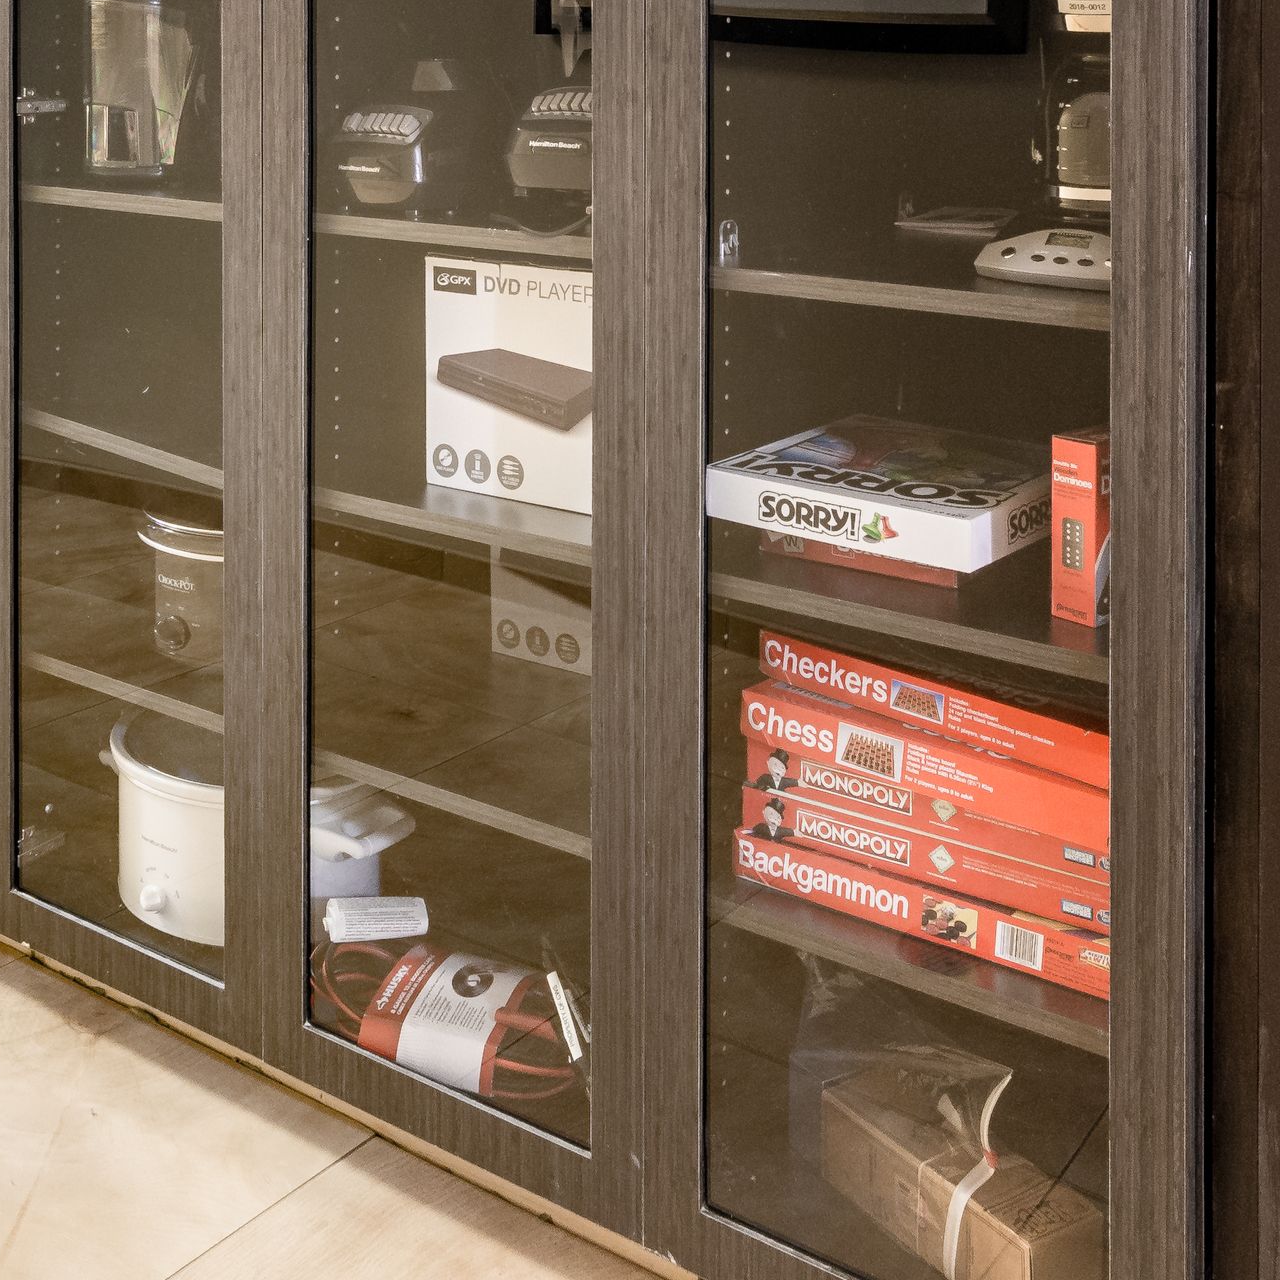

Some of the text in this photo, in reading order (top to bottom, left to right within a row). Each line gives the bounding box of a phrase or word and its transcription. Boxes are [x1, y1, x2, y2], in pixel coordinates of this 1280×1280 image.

[529, 139, 581, 149] Hamilton Beach
[338, 164, 380, 173] Hamilton Beach
[450, 274, 471, 286] GPX
[483, 275, 521, 295] DVD
[1053, 472, 1093, 490] Dominoes
[760, 494, 857, 536] SORRY!
[764, 639, 888, 703] Checkers
[747, 701, 834, 754] Chess
[803, 765, 910, 813] MONOPOLY
[801, 816, 908, 861] MONOPOLY
[738, 839, 910, 918] Backgammon
[382, 964, 409, 1002] HUSKY
